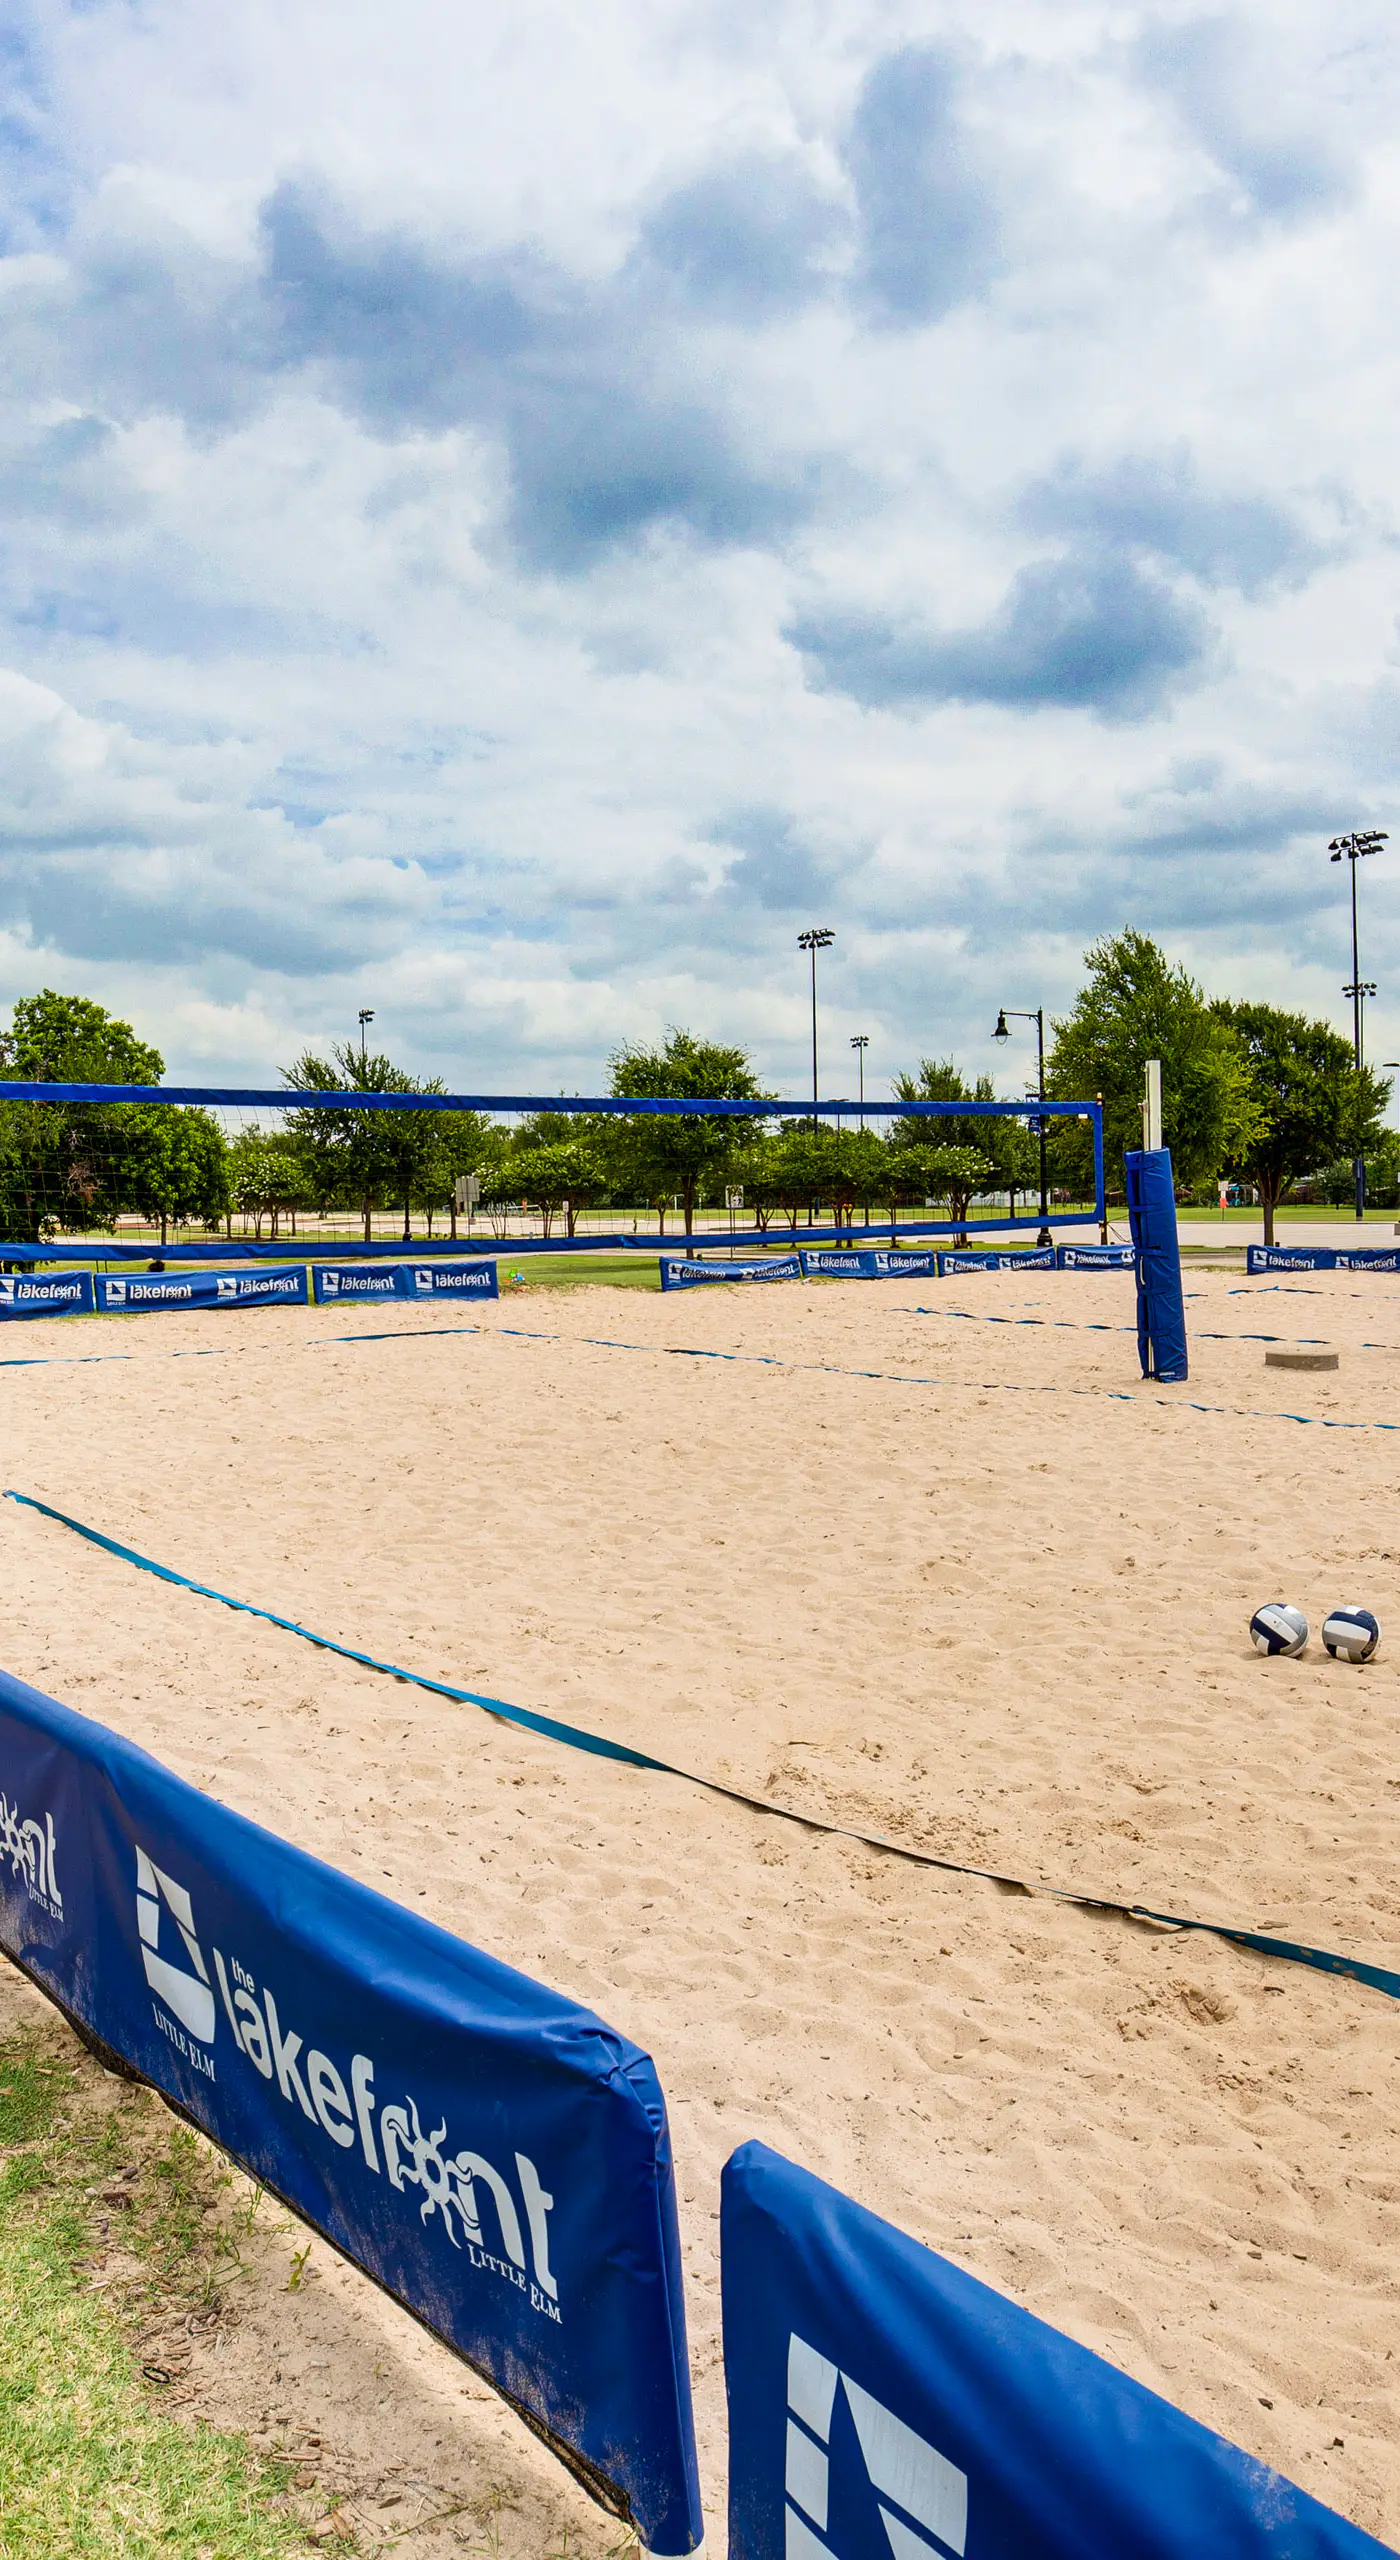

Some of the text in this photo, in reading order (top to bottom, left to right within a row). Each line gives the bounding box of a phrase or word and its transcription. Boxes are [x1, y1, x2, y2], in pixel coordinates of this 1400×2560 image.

[1268, 1255, 1315, 1269] lakefront
[240, 1277, 299, 1293] lakefront
[341, 1275, 395, 1290] lakefront
[435, 1271, 491, 1287] lakefront
[17, 1283, 82, 1299] lakefront
[129, 1284, 192, 1299] lakefront
[231, 1956, 255, 1993] the
[152, 2002, 216, 2082] LITTLE ELM
[213, 1947, 559, 2301] lakefront
[467, 2243, 563, 2325] LITTLE ELM
